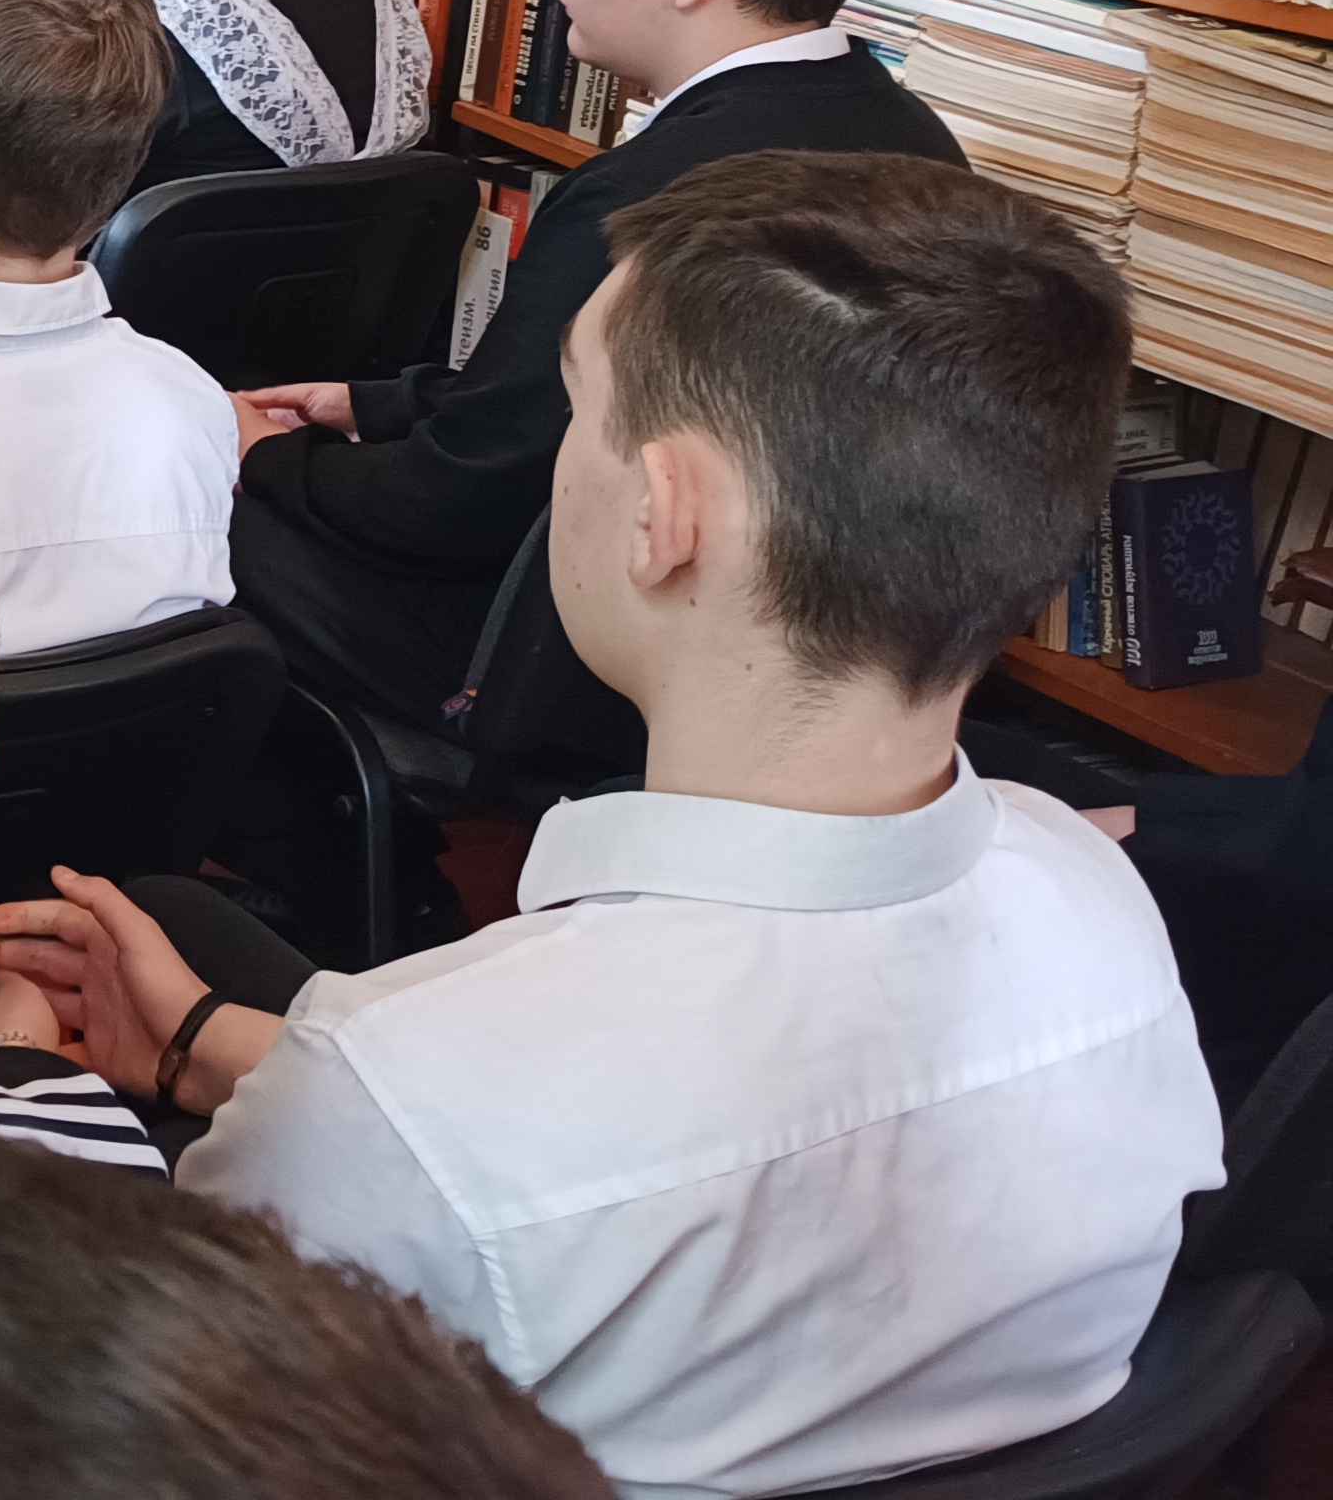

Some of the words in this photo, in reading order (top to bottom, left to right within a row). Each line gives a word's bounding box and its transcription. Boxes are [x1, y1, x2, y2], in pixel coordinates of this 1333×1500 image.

[465, 48, 476, 75] ПЕСНИ
[471, 7, 482, 34] СТИХИ
[474, 225, 492, 251] 86
[1101, 543, 1114, 598] СЛОВАРЬ
[1122, 535, 1137, 594] верующим
[1099, 599, 1115, 654] Карманный
[1124, 595, 1136, 636] ответов
[1124, 637, 1141, 667] 100
